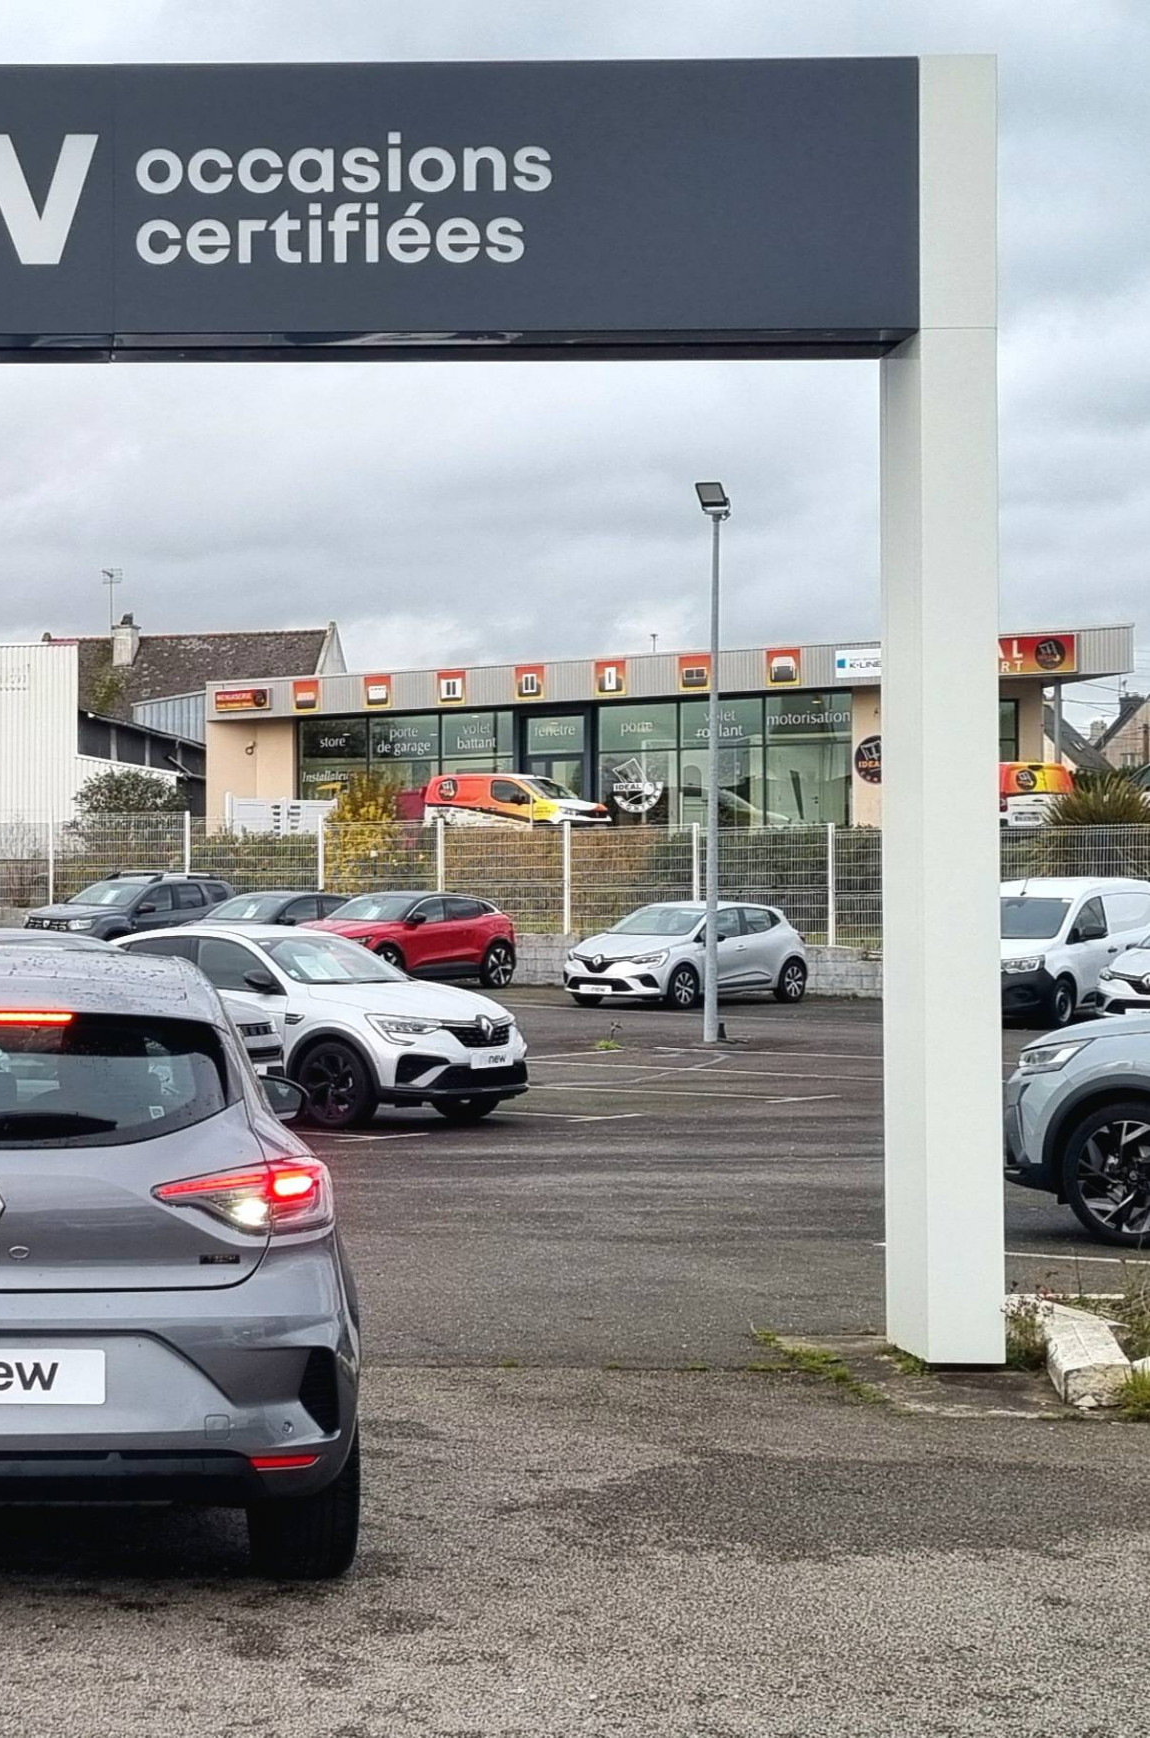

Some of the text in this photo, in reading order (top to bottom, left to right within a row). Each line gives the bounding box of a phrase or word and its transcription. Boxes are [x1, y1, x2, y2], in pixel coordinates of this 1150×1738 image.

[135, 131, 553, 194] occasions
[135, 202, 525, 265] certifiées
[703, 708, 736, 722] vlet
[766, 708, 851, 726] motorisation
[389, 726, 419, 741] porte
[462, 720, 491, 735] volet
[620, 717, 654, 736] porte
[696, 723, 744, 738] rolant
[319, 736, 346, 748] store
[377, 740, 431, 756] de garage
[457, 735, 496, 750] battant
[858, 760, 881, 769] IDEA
[614, 783, 642, 791] IDEAL
